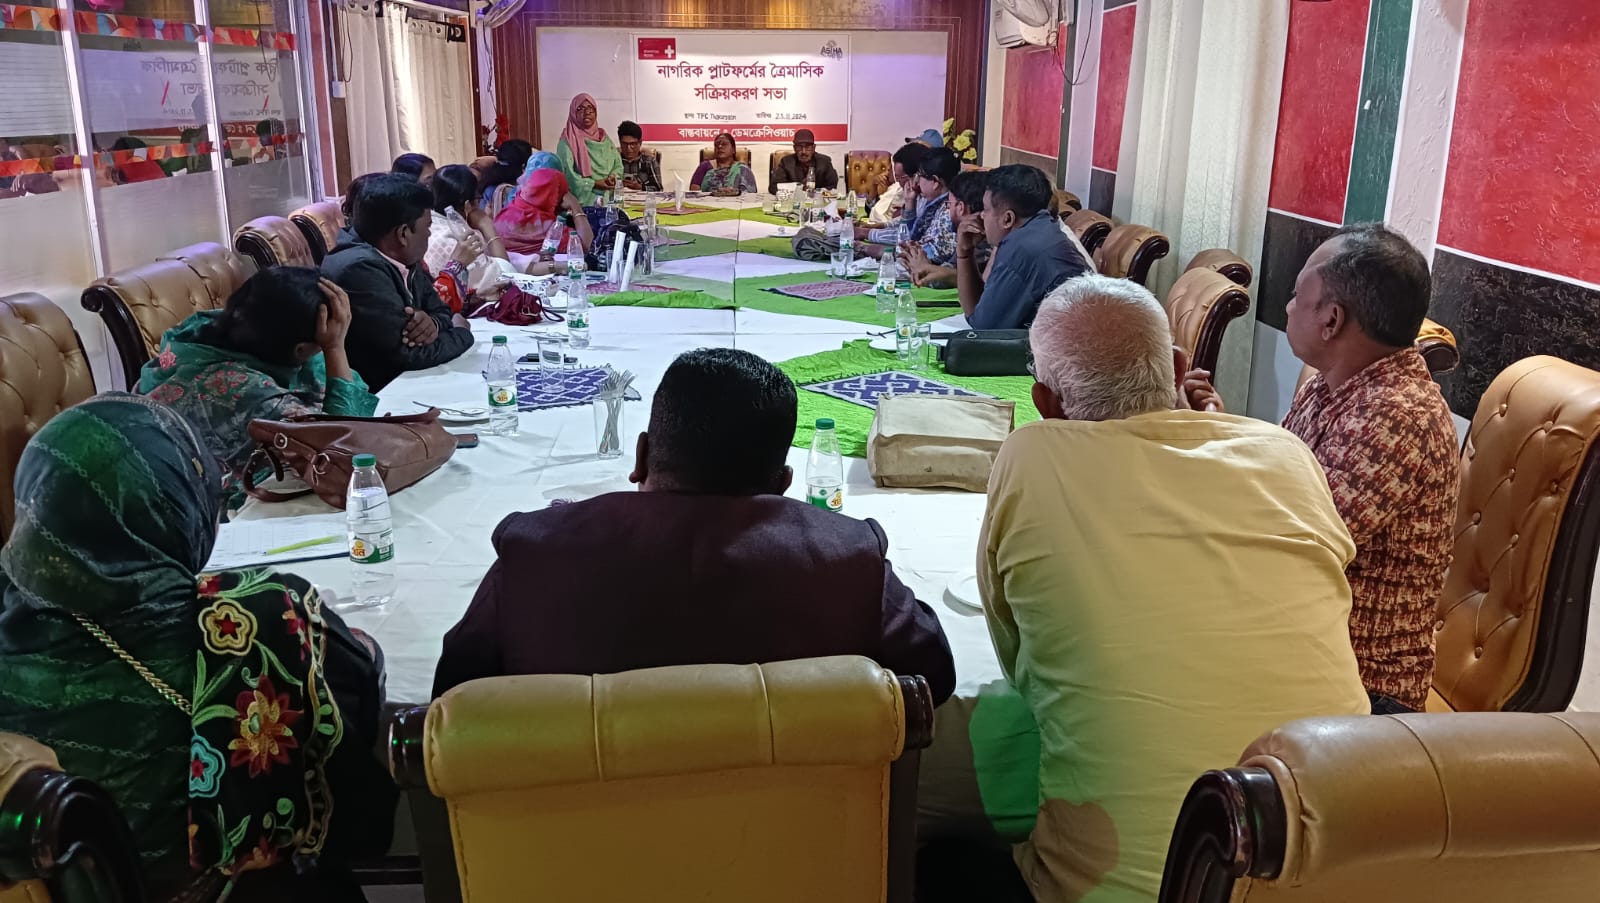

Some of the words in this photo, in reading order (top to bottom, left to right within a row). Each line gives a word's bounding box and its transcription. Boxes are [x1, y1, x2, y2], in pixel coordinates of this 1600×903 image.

[657, 61, 703, 79] নাগরিক
[708, 61, 766, 80] প্লাটফর্মের
[771, 61, 825, 79] ত্রৈমাসিক
[694, 84, 758, 101] সক্রিয়করণ
[763, 86, 787, 101] সভা
